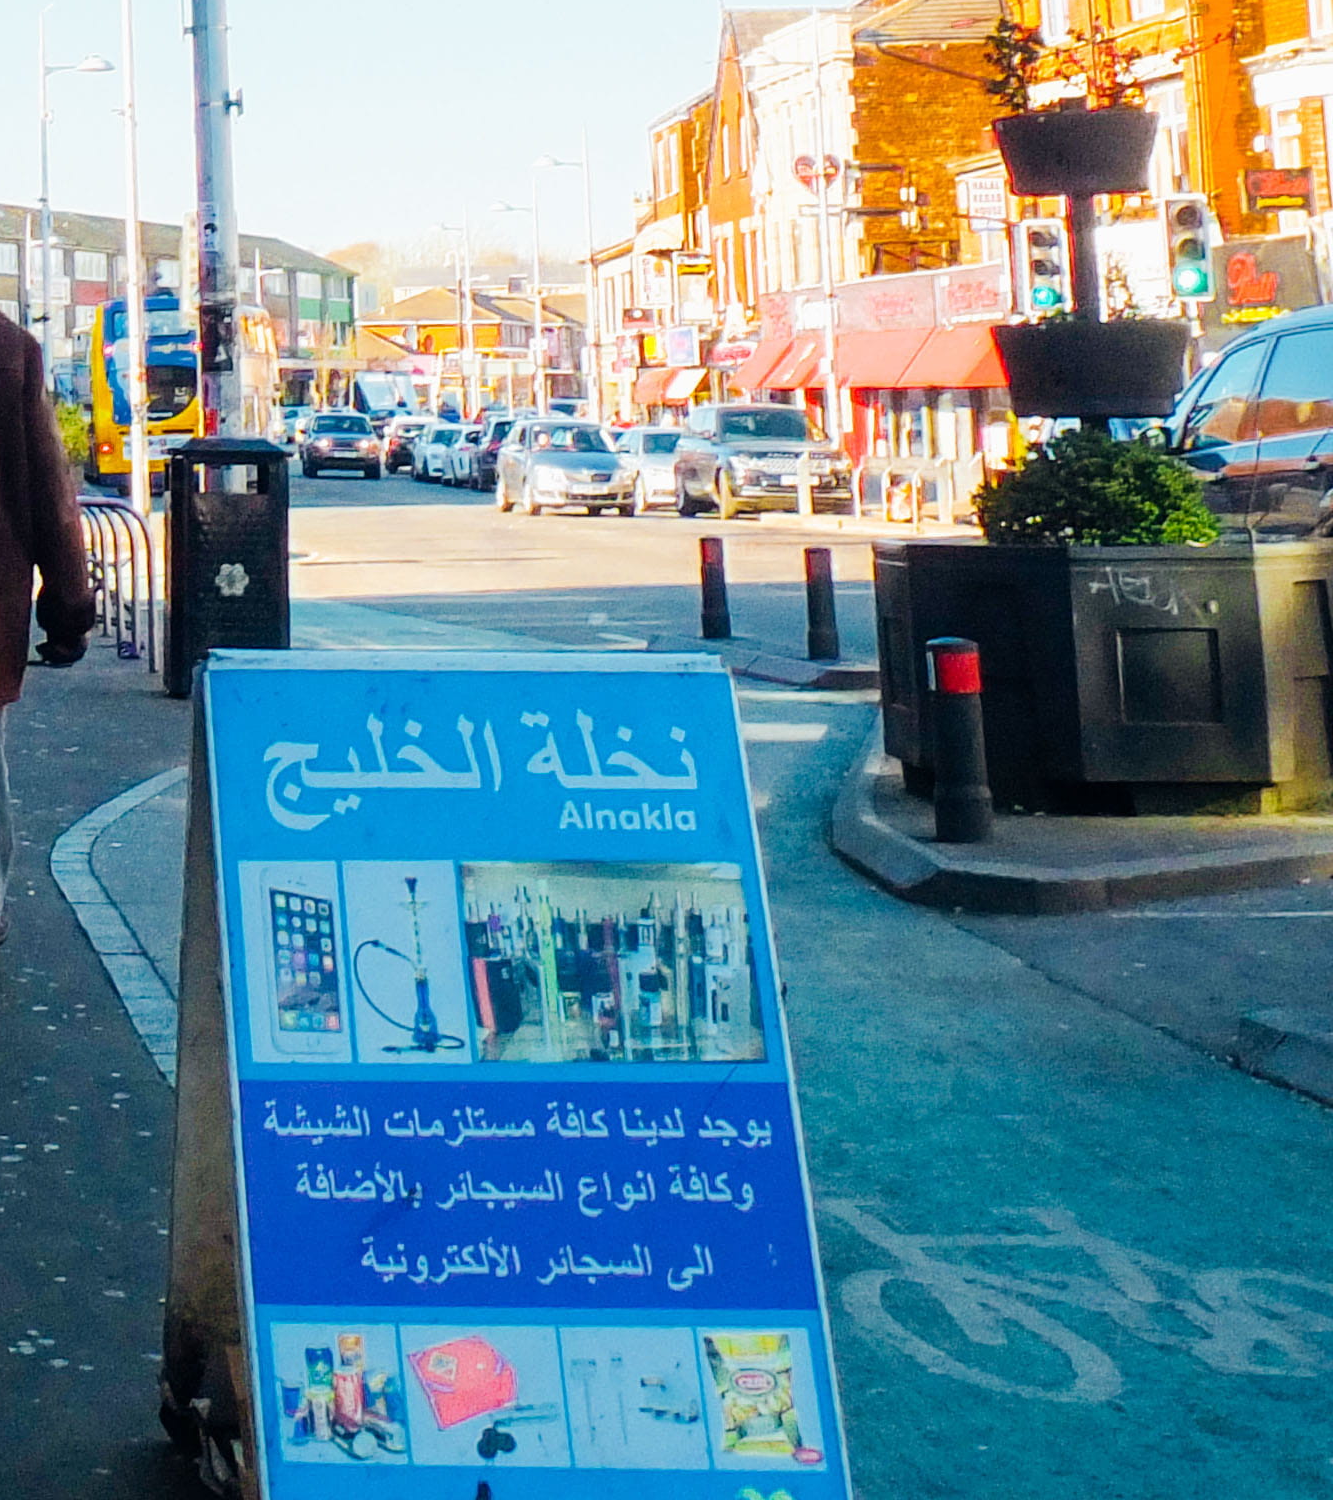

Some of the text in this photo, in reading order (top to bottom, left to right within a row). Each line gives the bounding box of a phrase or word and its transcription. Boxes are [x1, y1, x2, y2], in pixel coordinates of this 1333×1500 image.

[264, 708, 698, 831] نخلة الخليج
[559, 802, 697, 831] Alnakla
[263, 1099, 773, 1148] يوجد لدينا كافة مستلزمات الشيشة
[578, 1169, 656, 1217] انواع
[668, 1163, 755, 1212] وكافة
[536, 1243, 653, 1285] السجائر
[667, 1243, 714, 1290] الى
